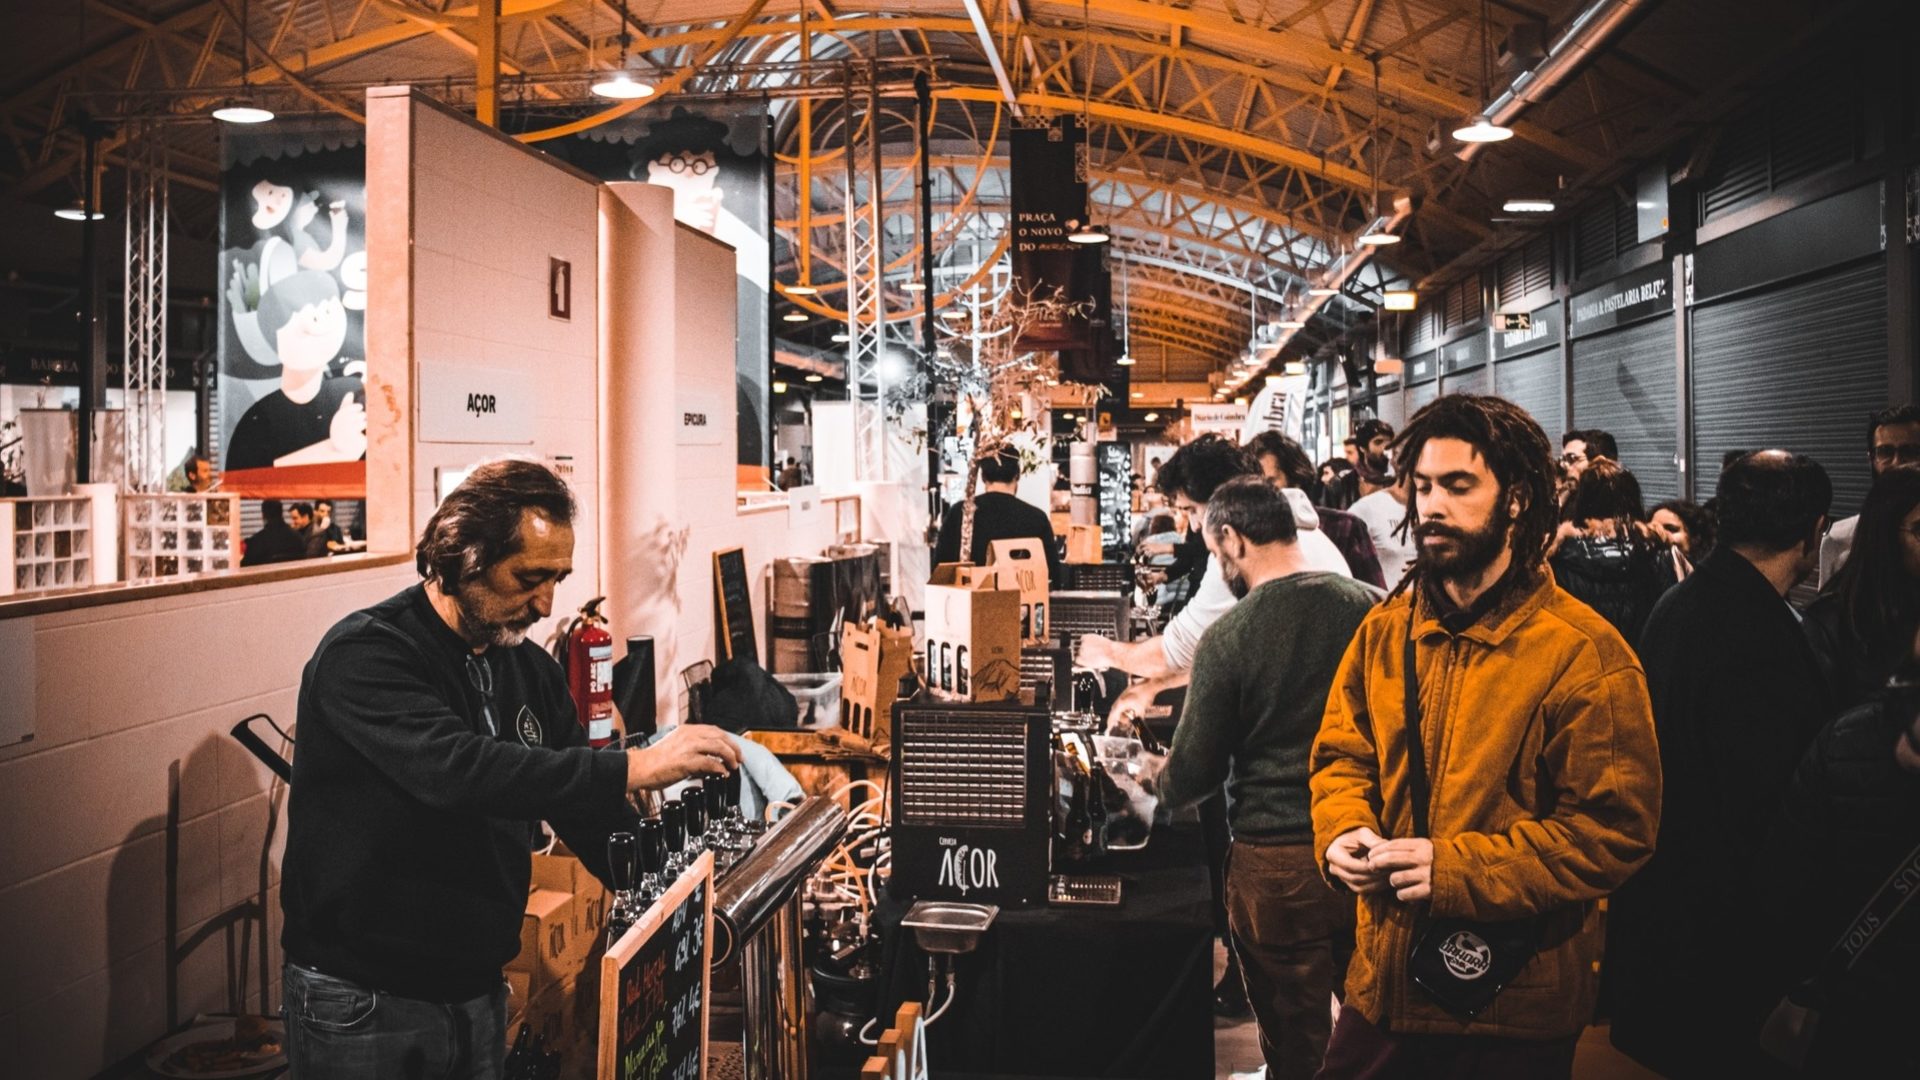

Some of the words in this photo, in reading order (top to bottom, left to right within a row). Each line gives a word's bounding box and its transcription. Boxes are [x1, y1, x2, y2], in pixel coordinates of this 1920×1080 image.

[1018, 212, 1057, 224] PRAÇA
[1018, 227, 1028, 237] O
[1031, 227, 1063, 237] NOVO
[1018, 242, 1036, 252] DO
[1604, 287, 1641, 314] PASTELARIA
[466, 392, 497, 418] AÇOR
[684, 412, 707, 426] EPICURA
[938, 844, 999, 897] AÇOR
[1841, 911, 1881, 956] TOUS
